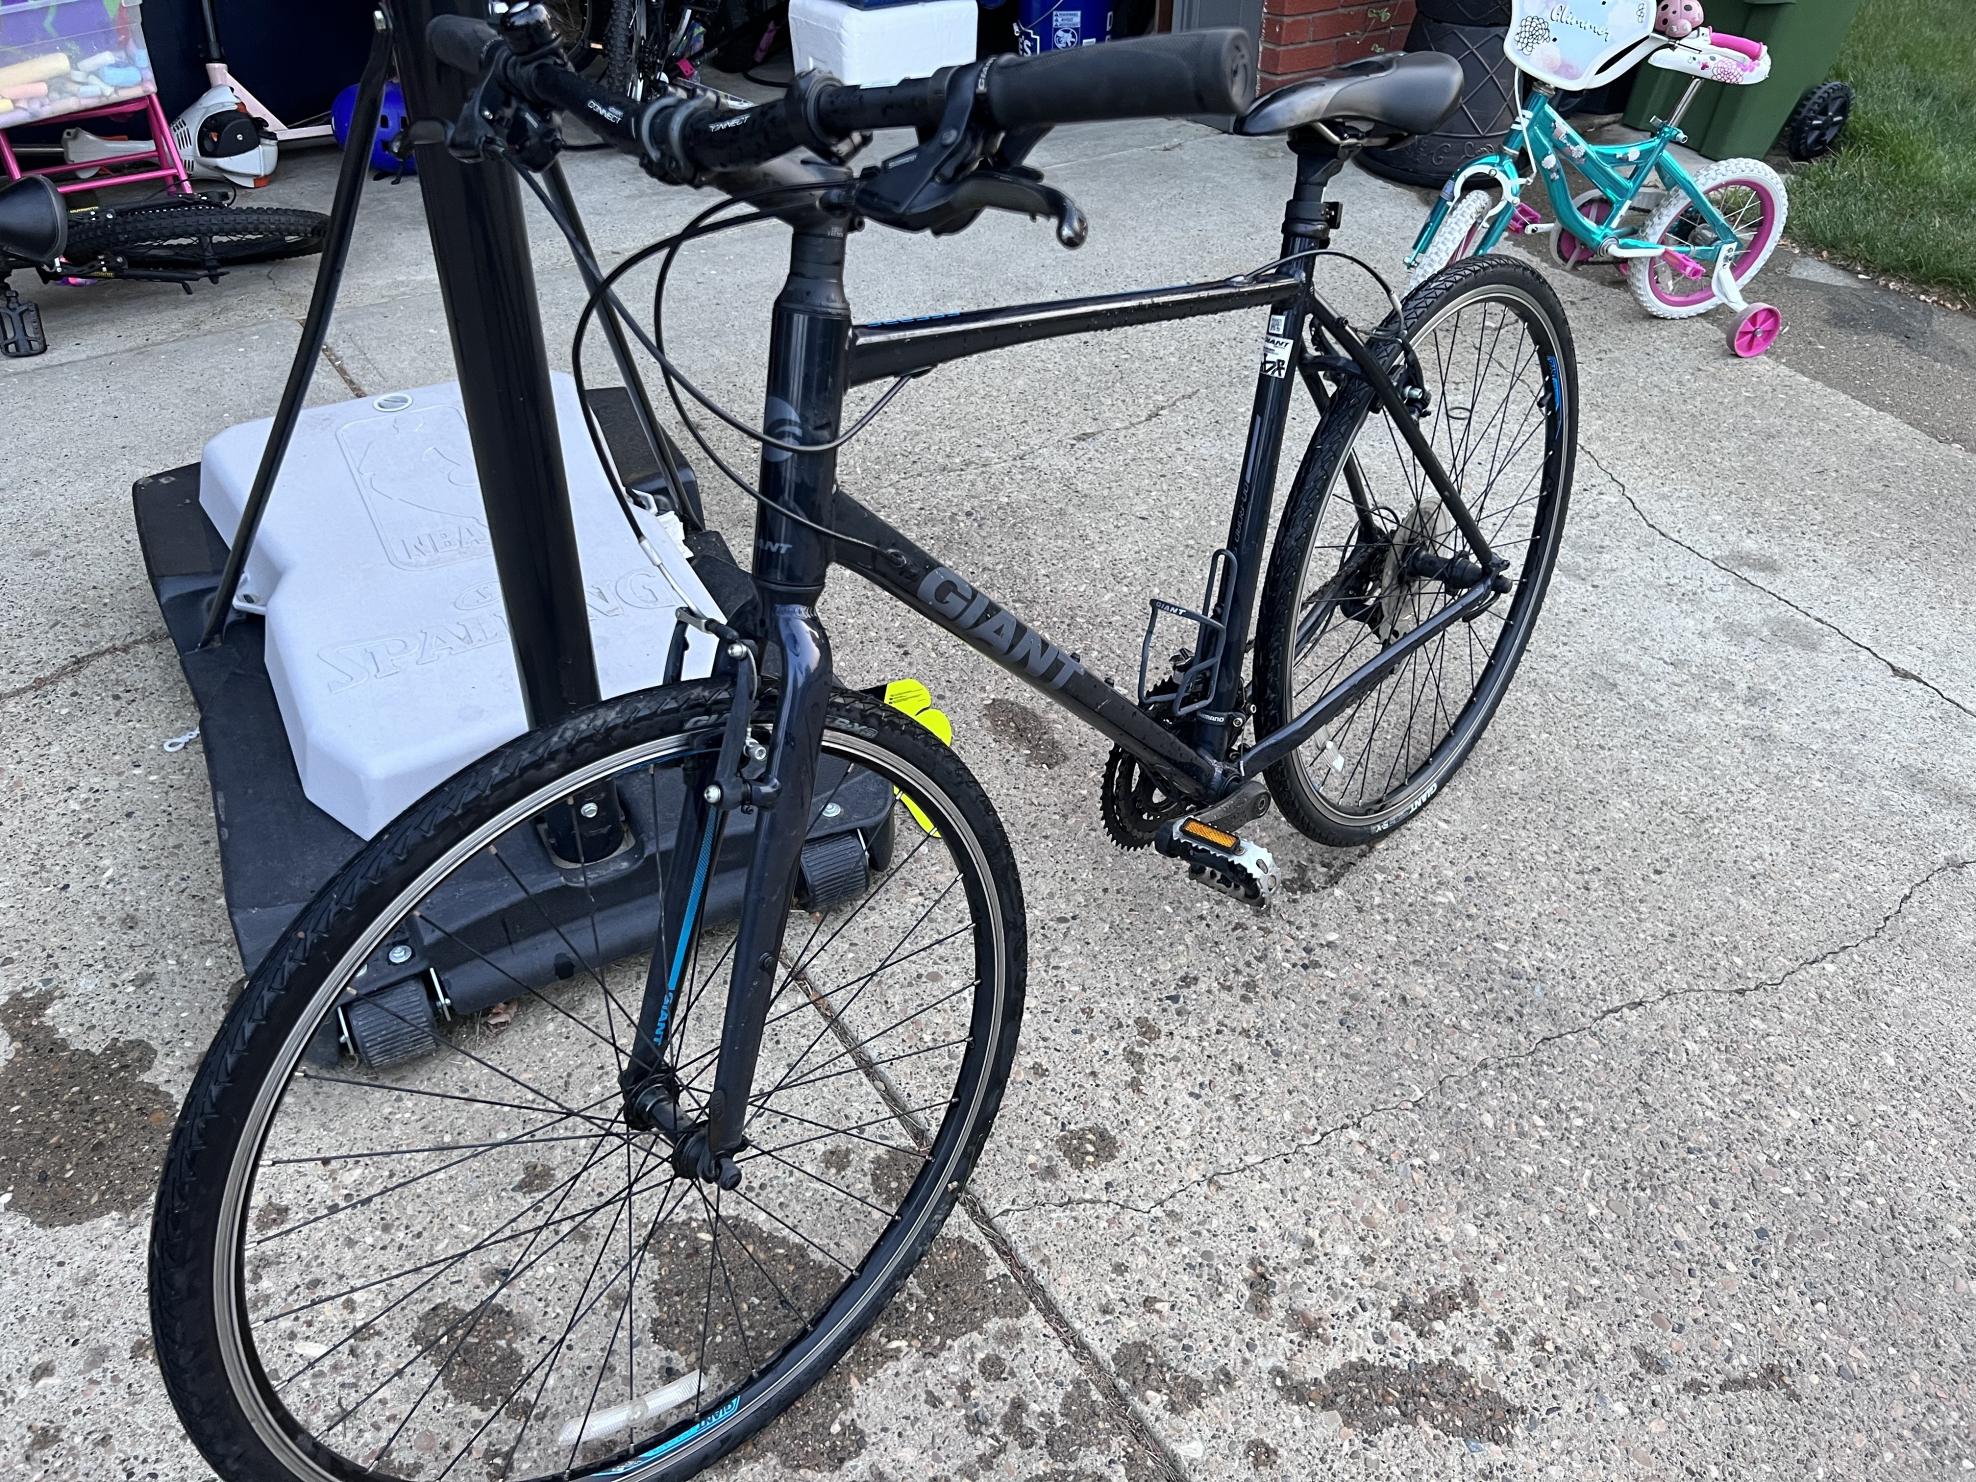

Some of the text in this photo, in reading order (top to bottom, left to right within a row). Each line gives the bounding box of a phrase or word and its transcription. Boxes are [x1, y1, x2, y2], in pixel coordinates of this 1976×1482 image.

[586, 100, 622, 124] CONNECT
[401, 525, 493, 560] NBA
[1155, 601, 1186, 616] GIANT
[917, 566, 1085, 690] GIANT
[1409, 782, 1438, 814] GIANT
[653, 991, 674, 1047] GIANT
